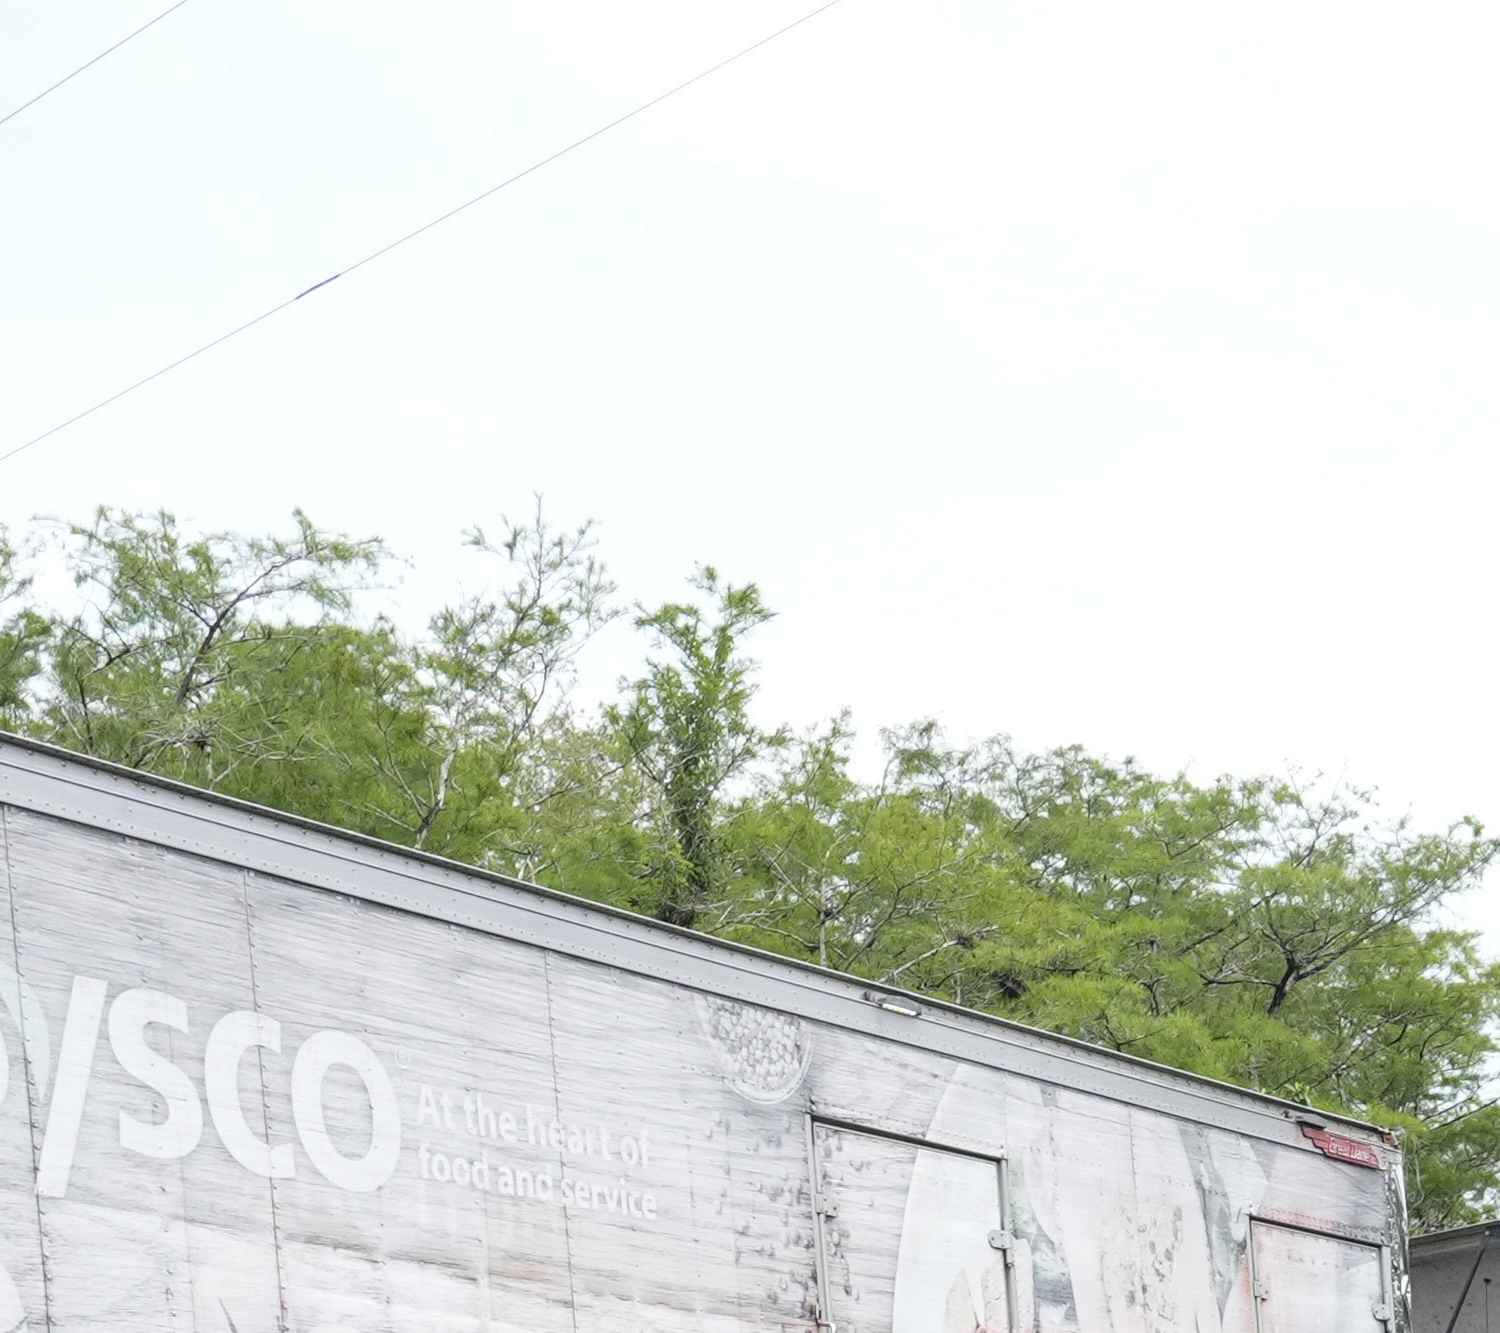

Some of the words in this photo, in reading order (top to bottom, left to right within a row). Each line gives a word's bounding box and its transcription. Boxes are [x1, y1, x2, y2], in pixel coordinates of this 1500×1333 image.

[415, 1083, 454, 1132] At
[461, 1090, 518, 1143] the
[525, 1103, 613, 1163] heart
[620, 1128, 651, 1168] of
[417, 1141, 490, 1192] food
[497, 1162, 553, 1202] and
[560, 1176, 658, 1220] service
